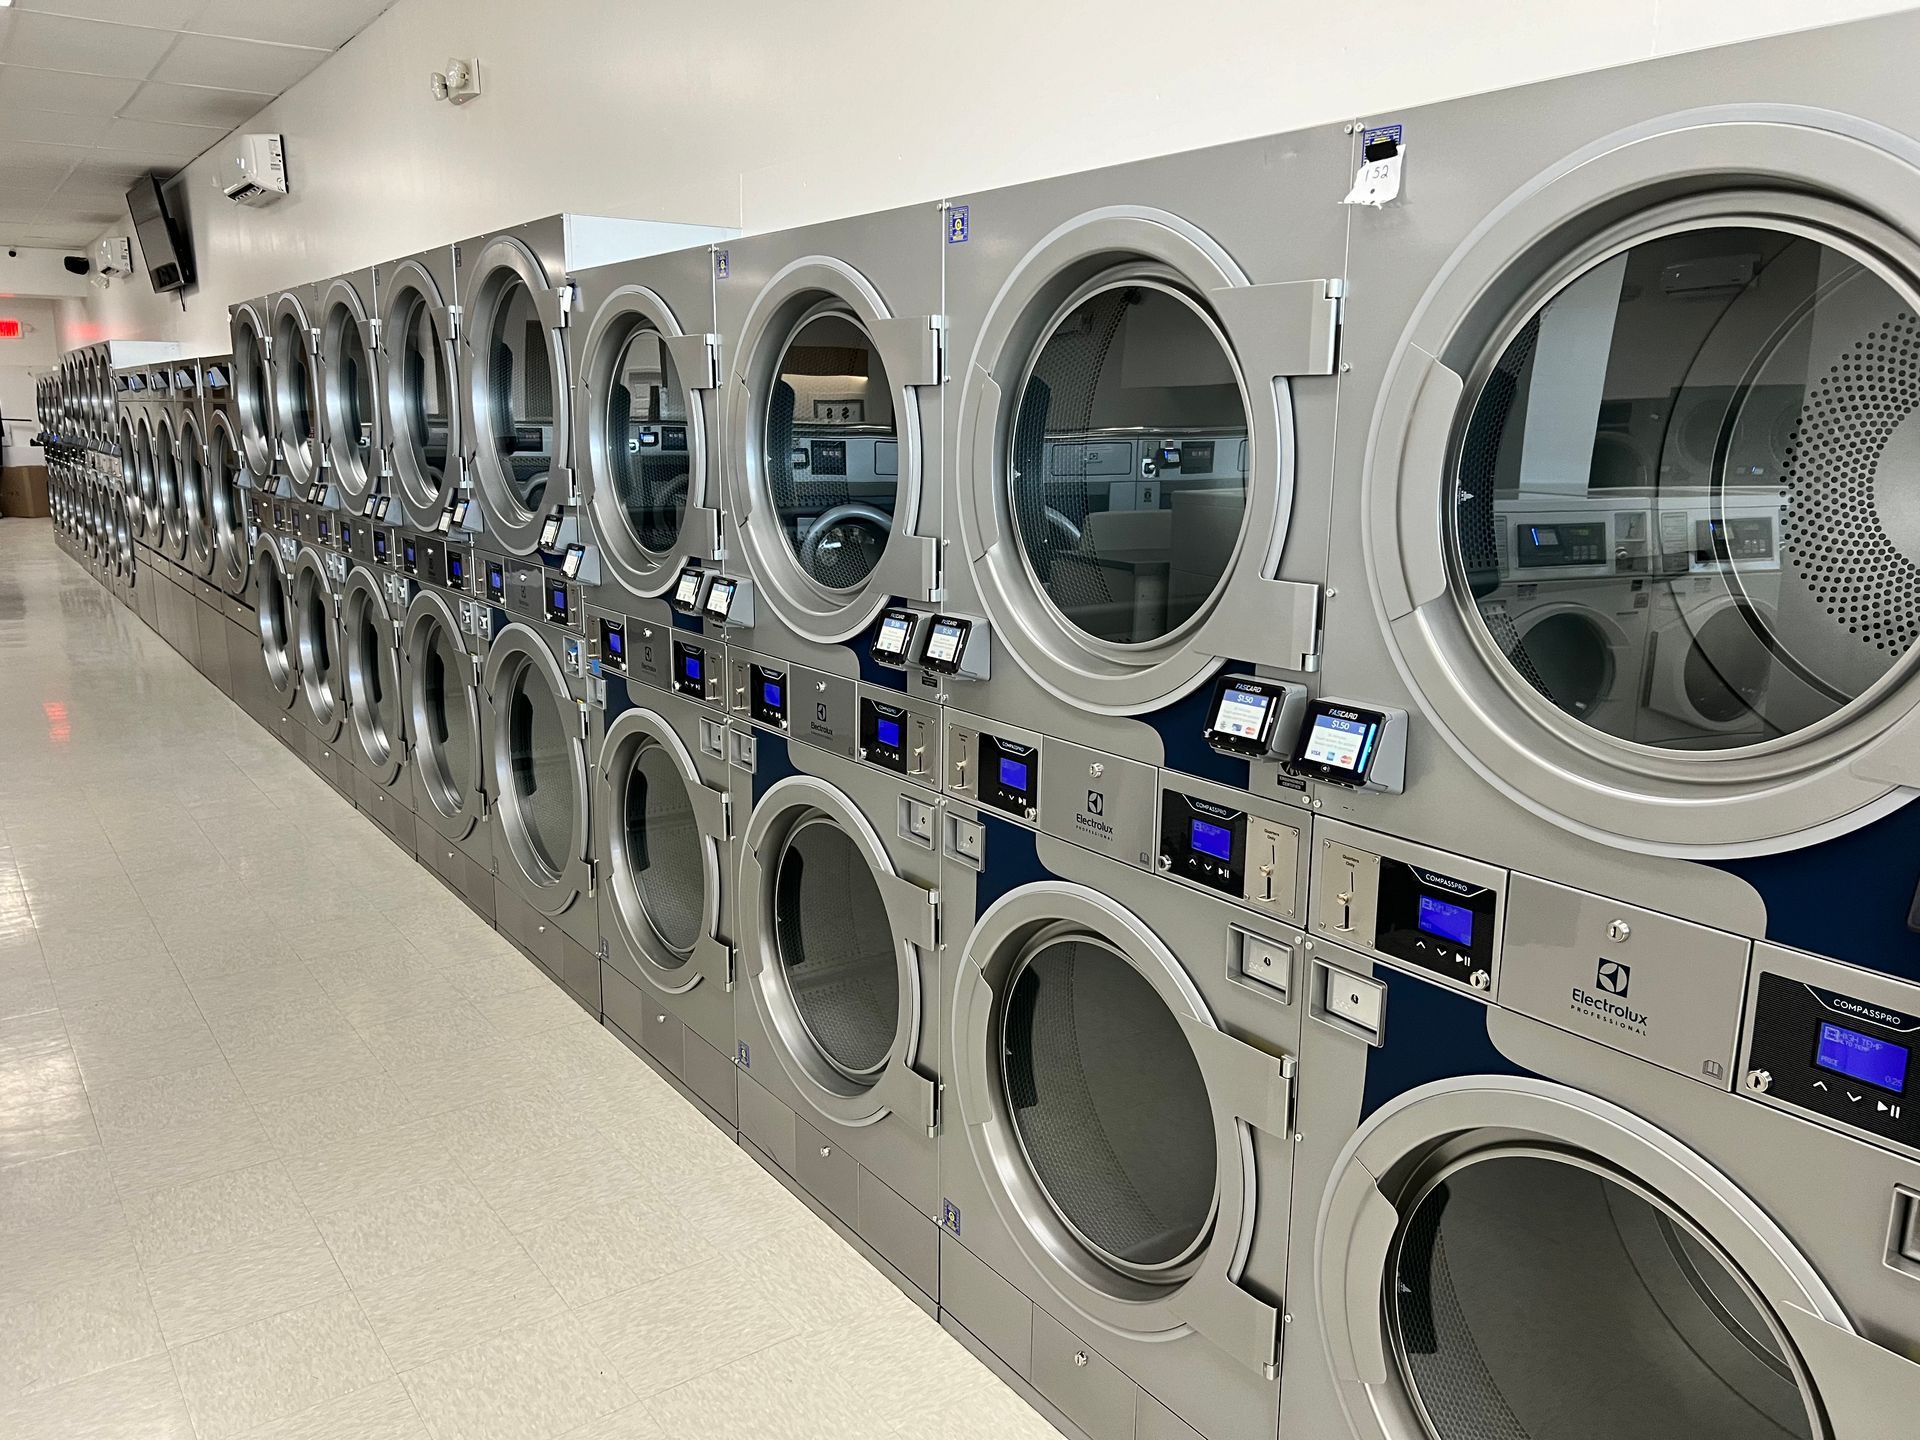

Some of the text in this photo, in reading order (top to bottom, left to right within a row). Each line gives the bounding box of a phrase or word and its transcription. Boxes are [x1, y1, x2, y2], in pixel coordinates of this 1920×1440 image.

[1365, 165, 1389, 182] 152
[1235, 683, 1262, 693] FASCARD
[1328, 708, 1359, 720] FASCARD
[1331, 720, 1350, 730] $1.50
[1195, 801, 1227, 816] COMPASSPRO
[1076, 813, 1113, 834] Electrolux
[1425, 873, 1468, 892] COMPASSPRO
[1572, 987, 1648, 1027] Electrolux
[1833, 998, 1901, 1025] COMPASSPRO
[1570, 1004, 1647, 1036] PROFESSIONAL
